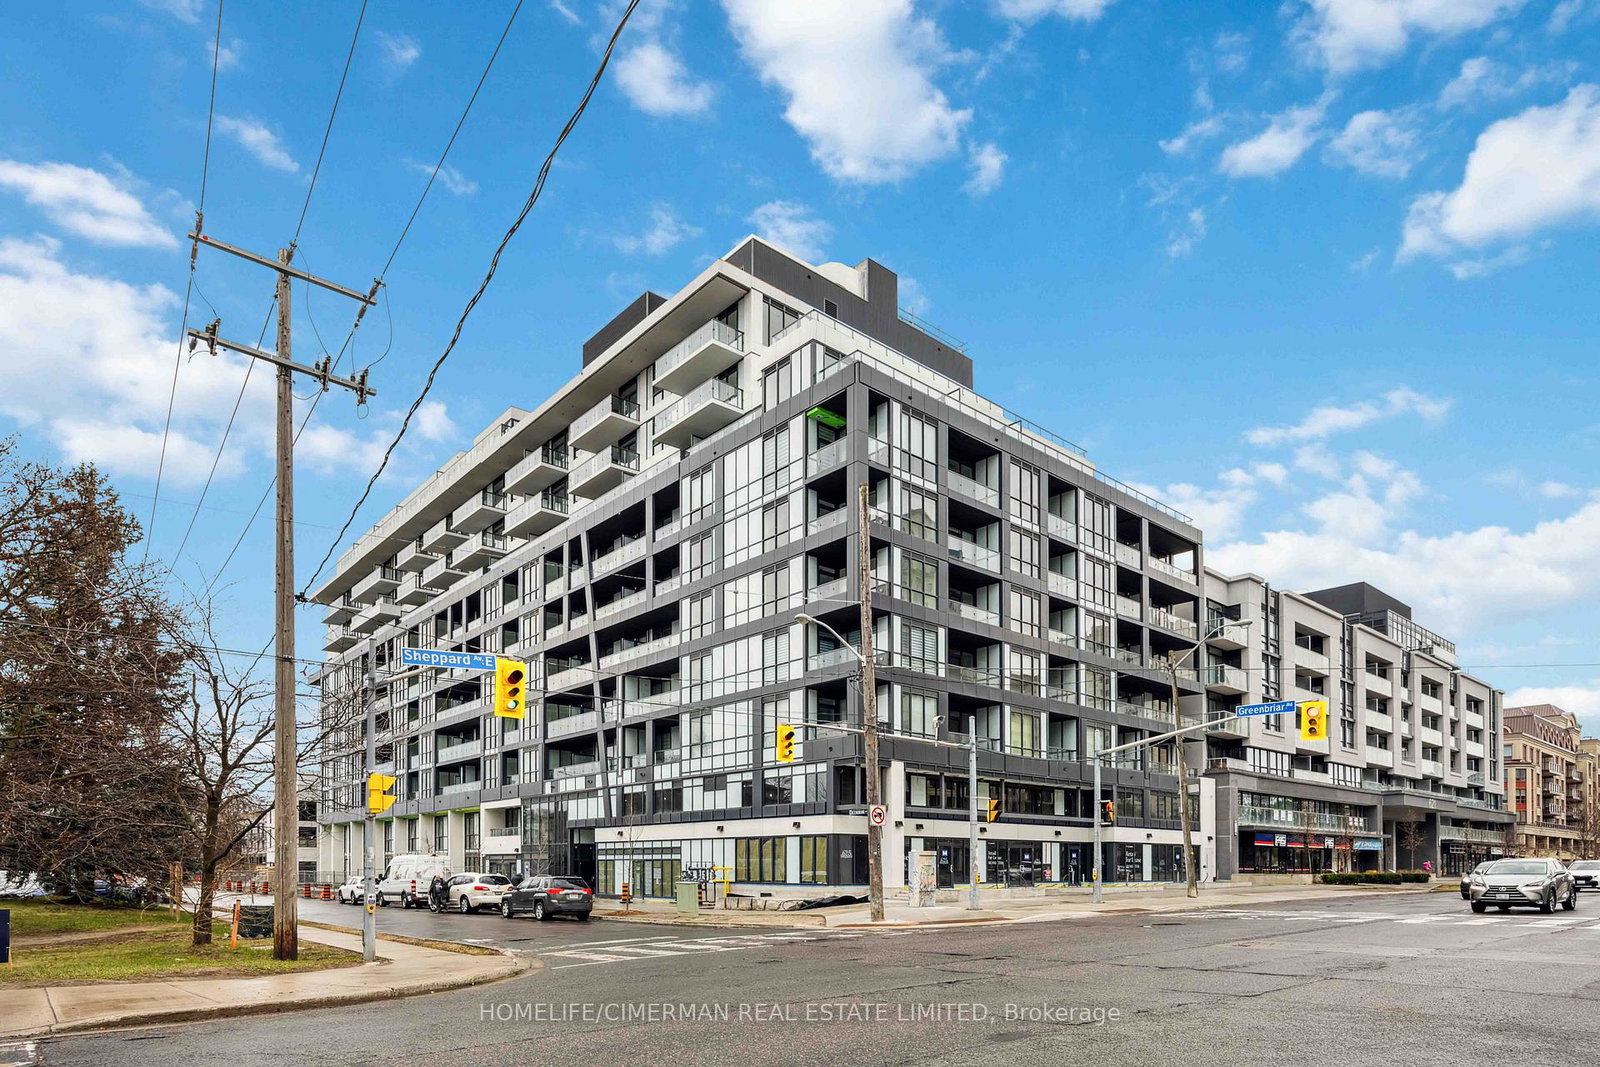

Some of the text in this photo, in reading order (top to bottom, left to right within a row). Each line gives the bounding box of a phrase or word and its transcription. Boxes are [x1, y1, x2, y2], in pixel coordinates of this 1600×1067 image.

[404, 650, 470, 665] Sheppard
[485, 656, 494, 667] E
[1238, 704, 1285, 715] Greenbriar
